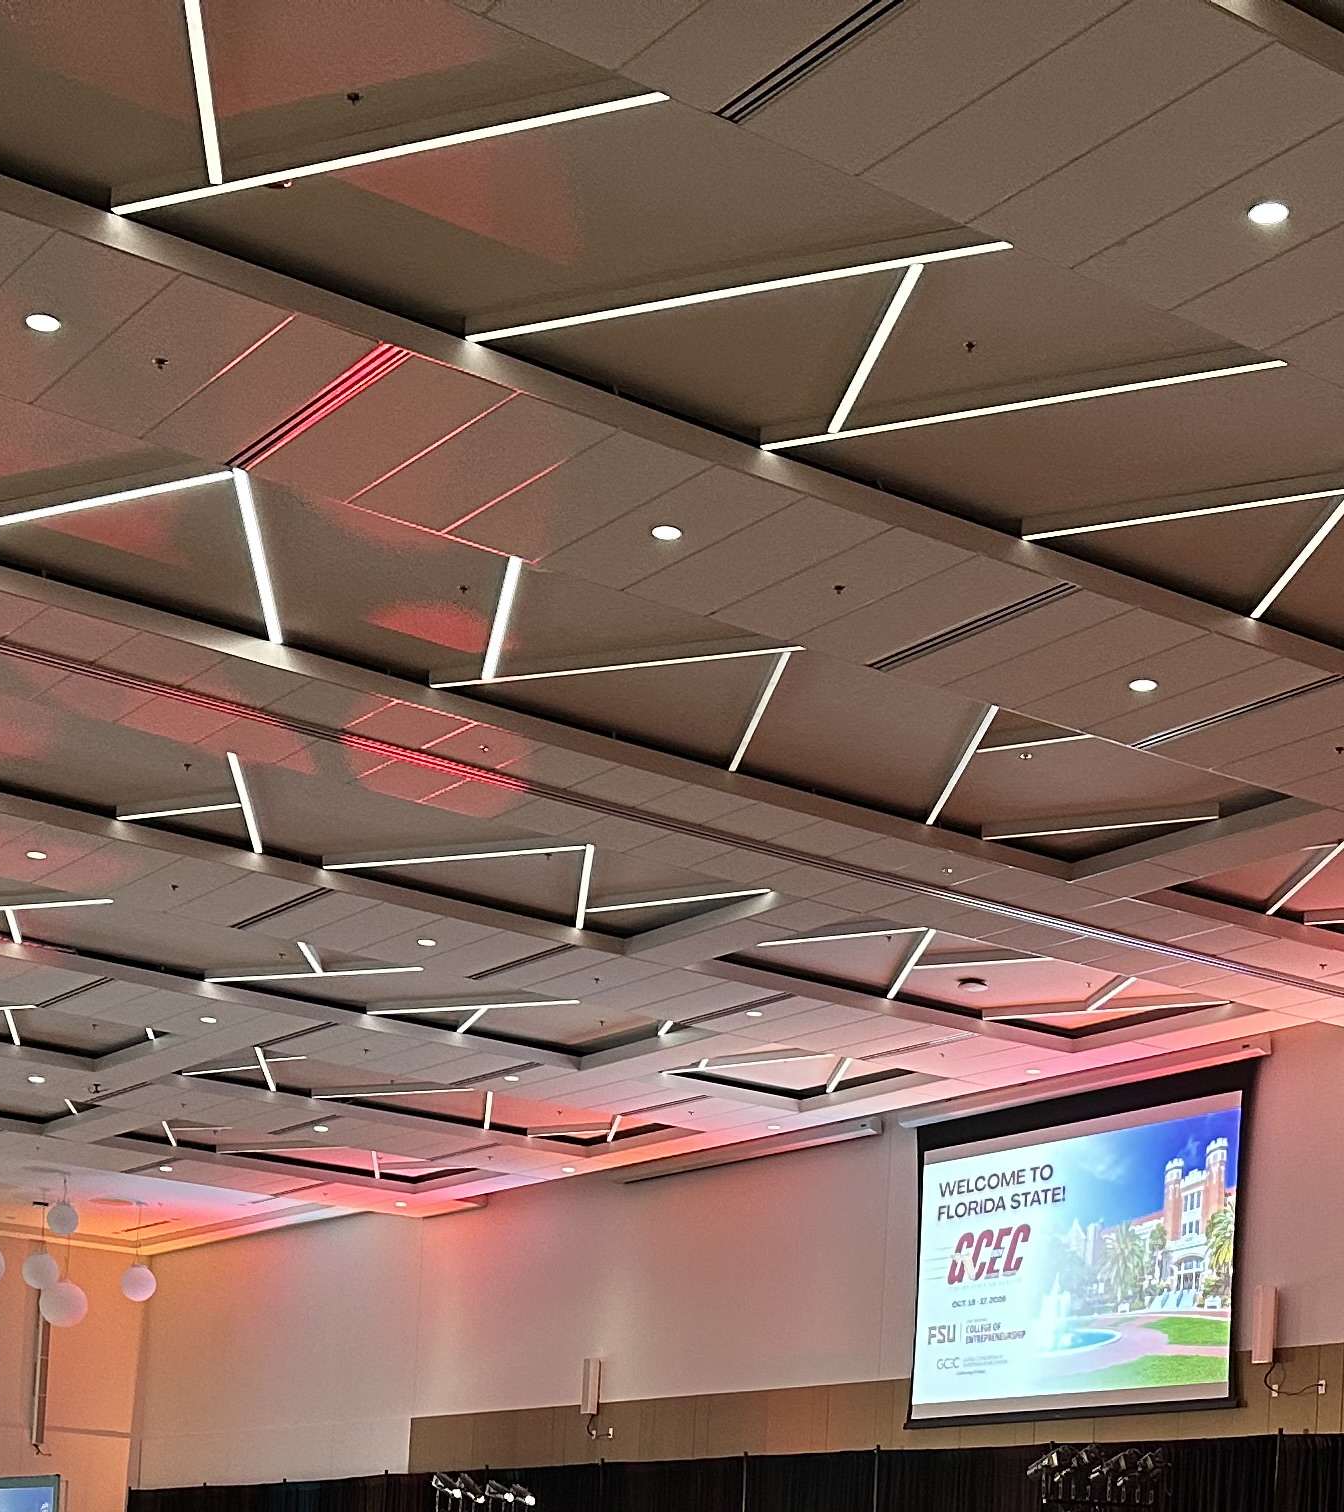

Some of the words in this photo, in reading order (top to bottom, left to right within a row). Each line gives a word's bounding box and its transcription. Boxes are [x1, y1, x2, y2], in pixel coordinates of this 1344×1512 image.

[939, 1169, 1026, 1198] WELCOME
[1030, 1164, 1053, 1182] TO
[938, 1196, 1006, 1221] FLORIDA
[1010, 1186, 1066, 1209] STATE!
[947, 1223, 1031, 1285] GCEC
[927, 1324, 956, 1345] FSU
